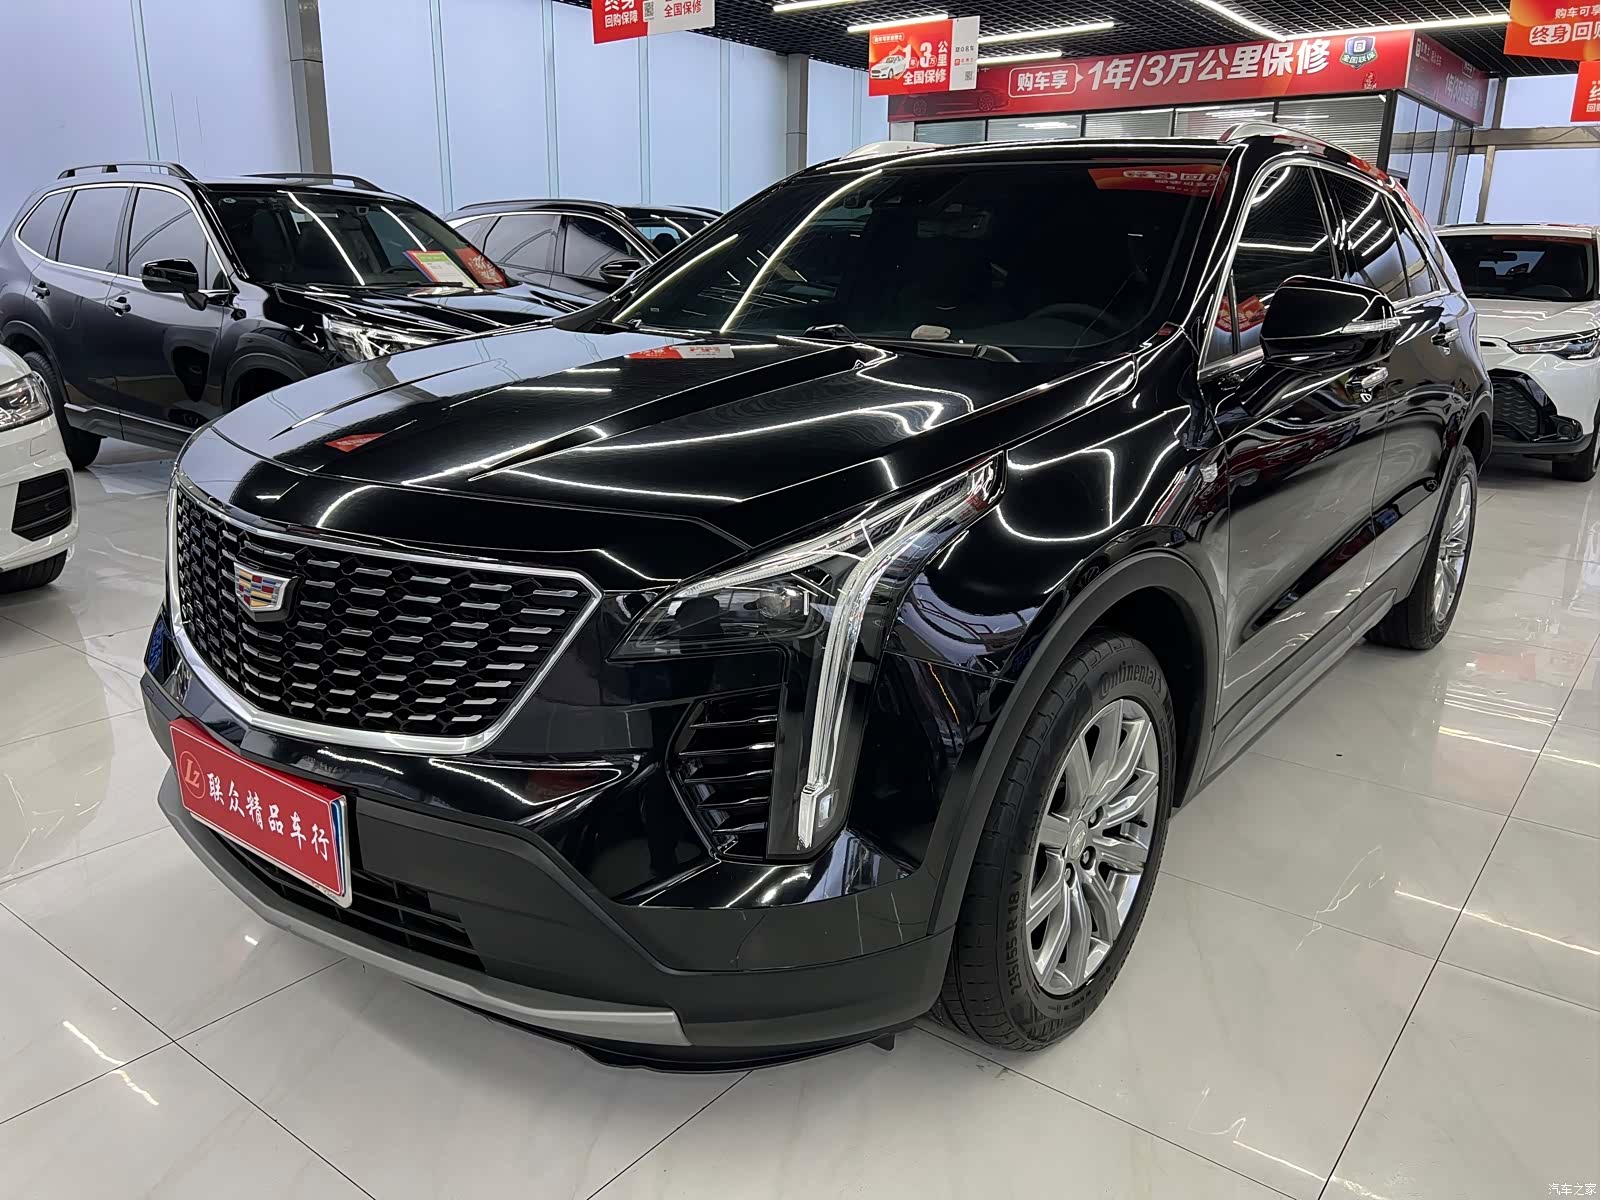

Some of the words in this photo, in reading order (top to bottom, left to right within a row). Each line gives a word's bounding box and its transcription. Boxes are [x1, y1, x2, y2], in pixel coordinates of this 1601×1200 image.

[604, 10, 638, 28] 回购保障
[664, 0, 702, 18] 全国保修
[1088, 39, 1331, 91] 1年/3万公里保修
[903, 69, 947, 86] 全国保修
[1016, 70, 1069, 92] 购车享
[207, 772, 330, 862] 联众精品车行
